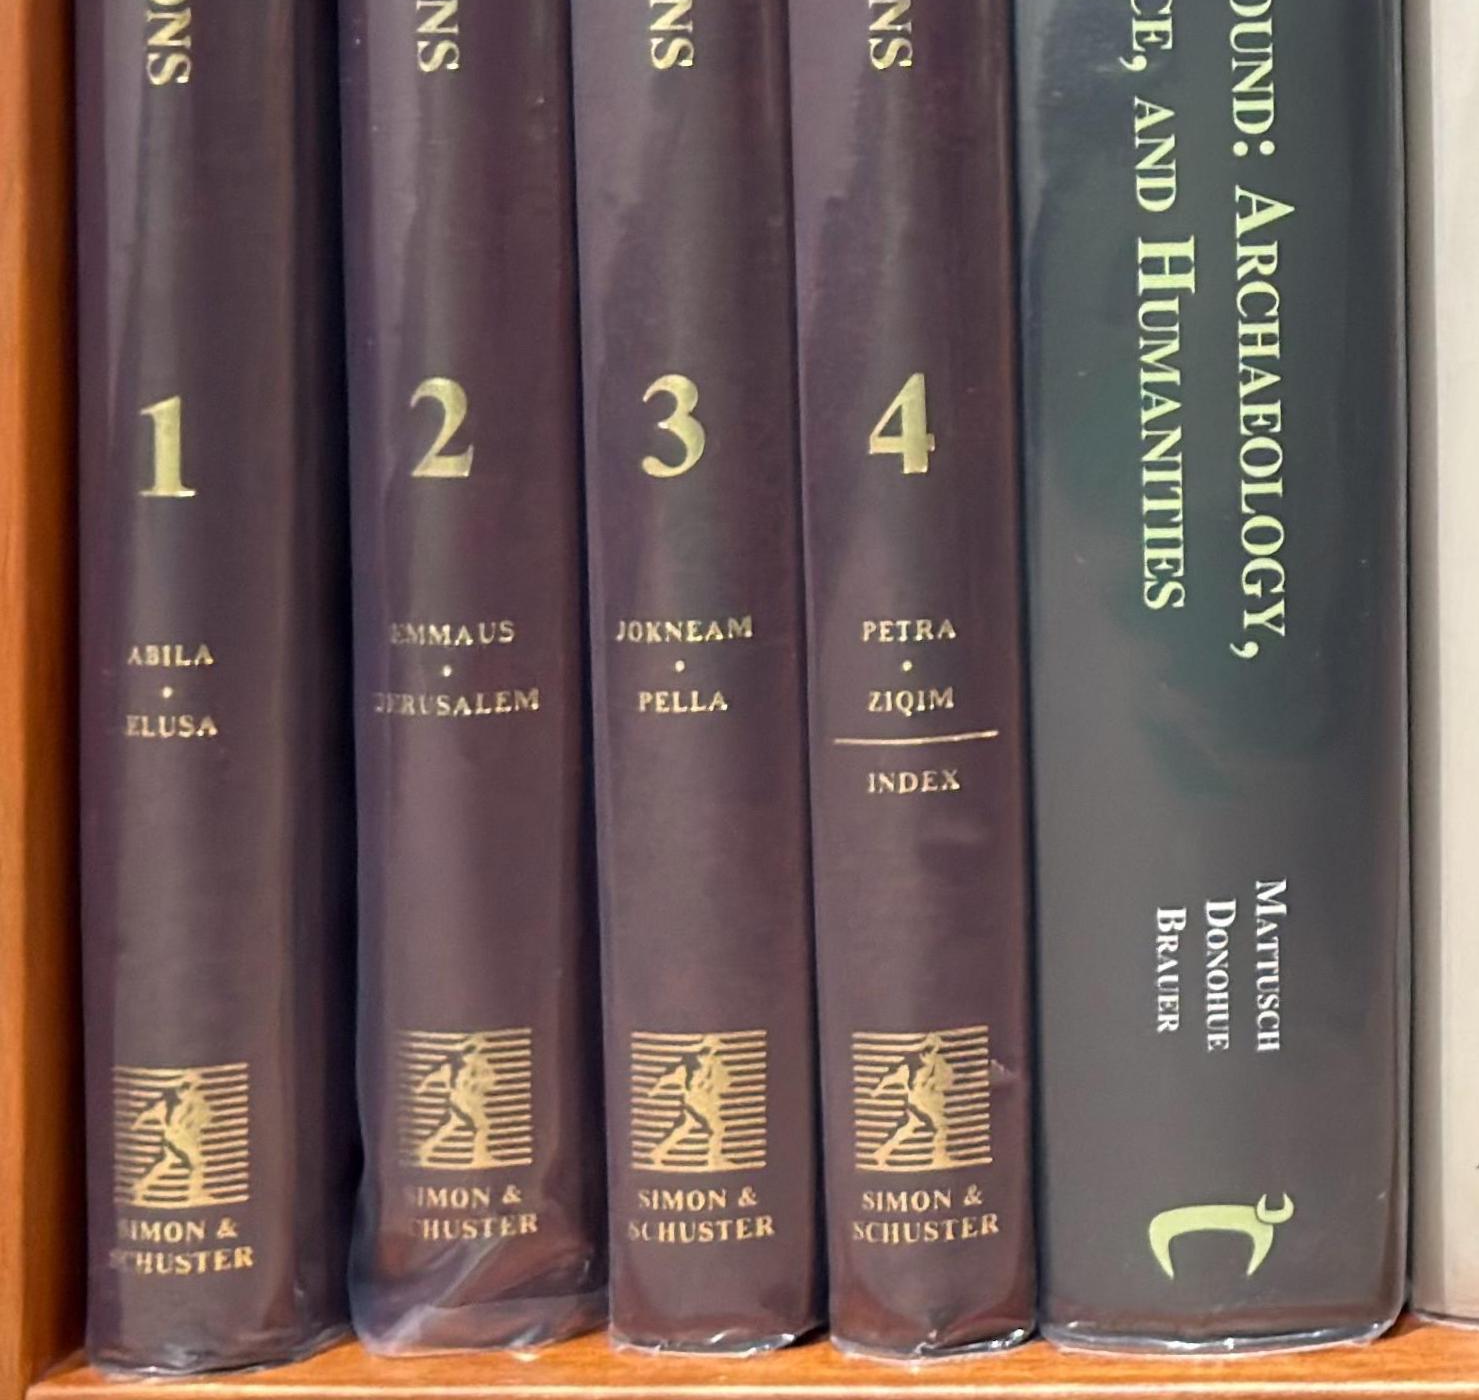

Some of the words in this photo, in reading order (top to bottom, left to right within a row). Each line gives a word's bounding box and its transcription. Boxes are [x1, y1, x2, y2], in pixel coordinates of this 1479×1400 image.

[410, 376, 474, 479] 2
[641, 373, 705, 477] 3
[868, 371, 935, 474] 4
[137, 396, 197, 497] 1
[616, 617, 752, 641] JOKNEAM
[861, 619, 955, 641] PETRA
[128, 644, 214, 668] ABILA
[638, 690, 727, 712] PELLA
[868, 687, 954, 713] ZIQIM
[125, 715, 217, 738] ELUSA
[867, 769, 959, 794] INDEX
[861, 1190, 951, 1212] SIMON
[960, 1187, 981, 1208] &
